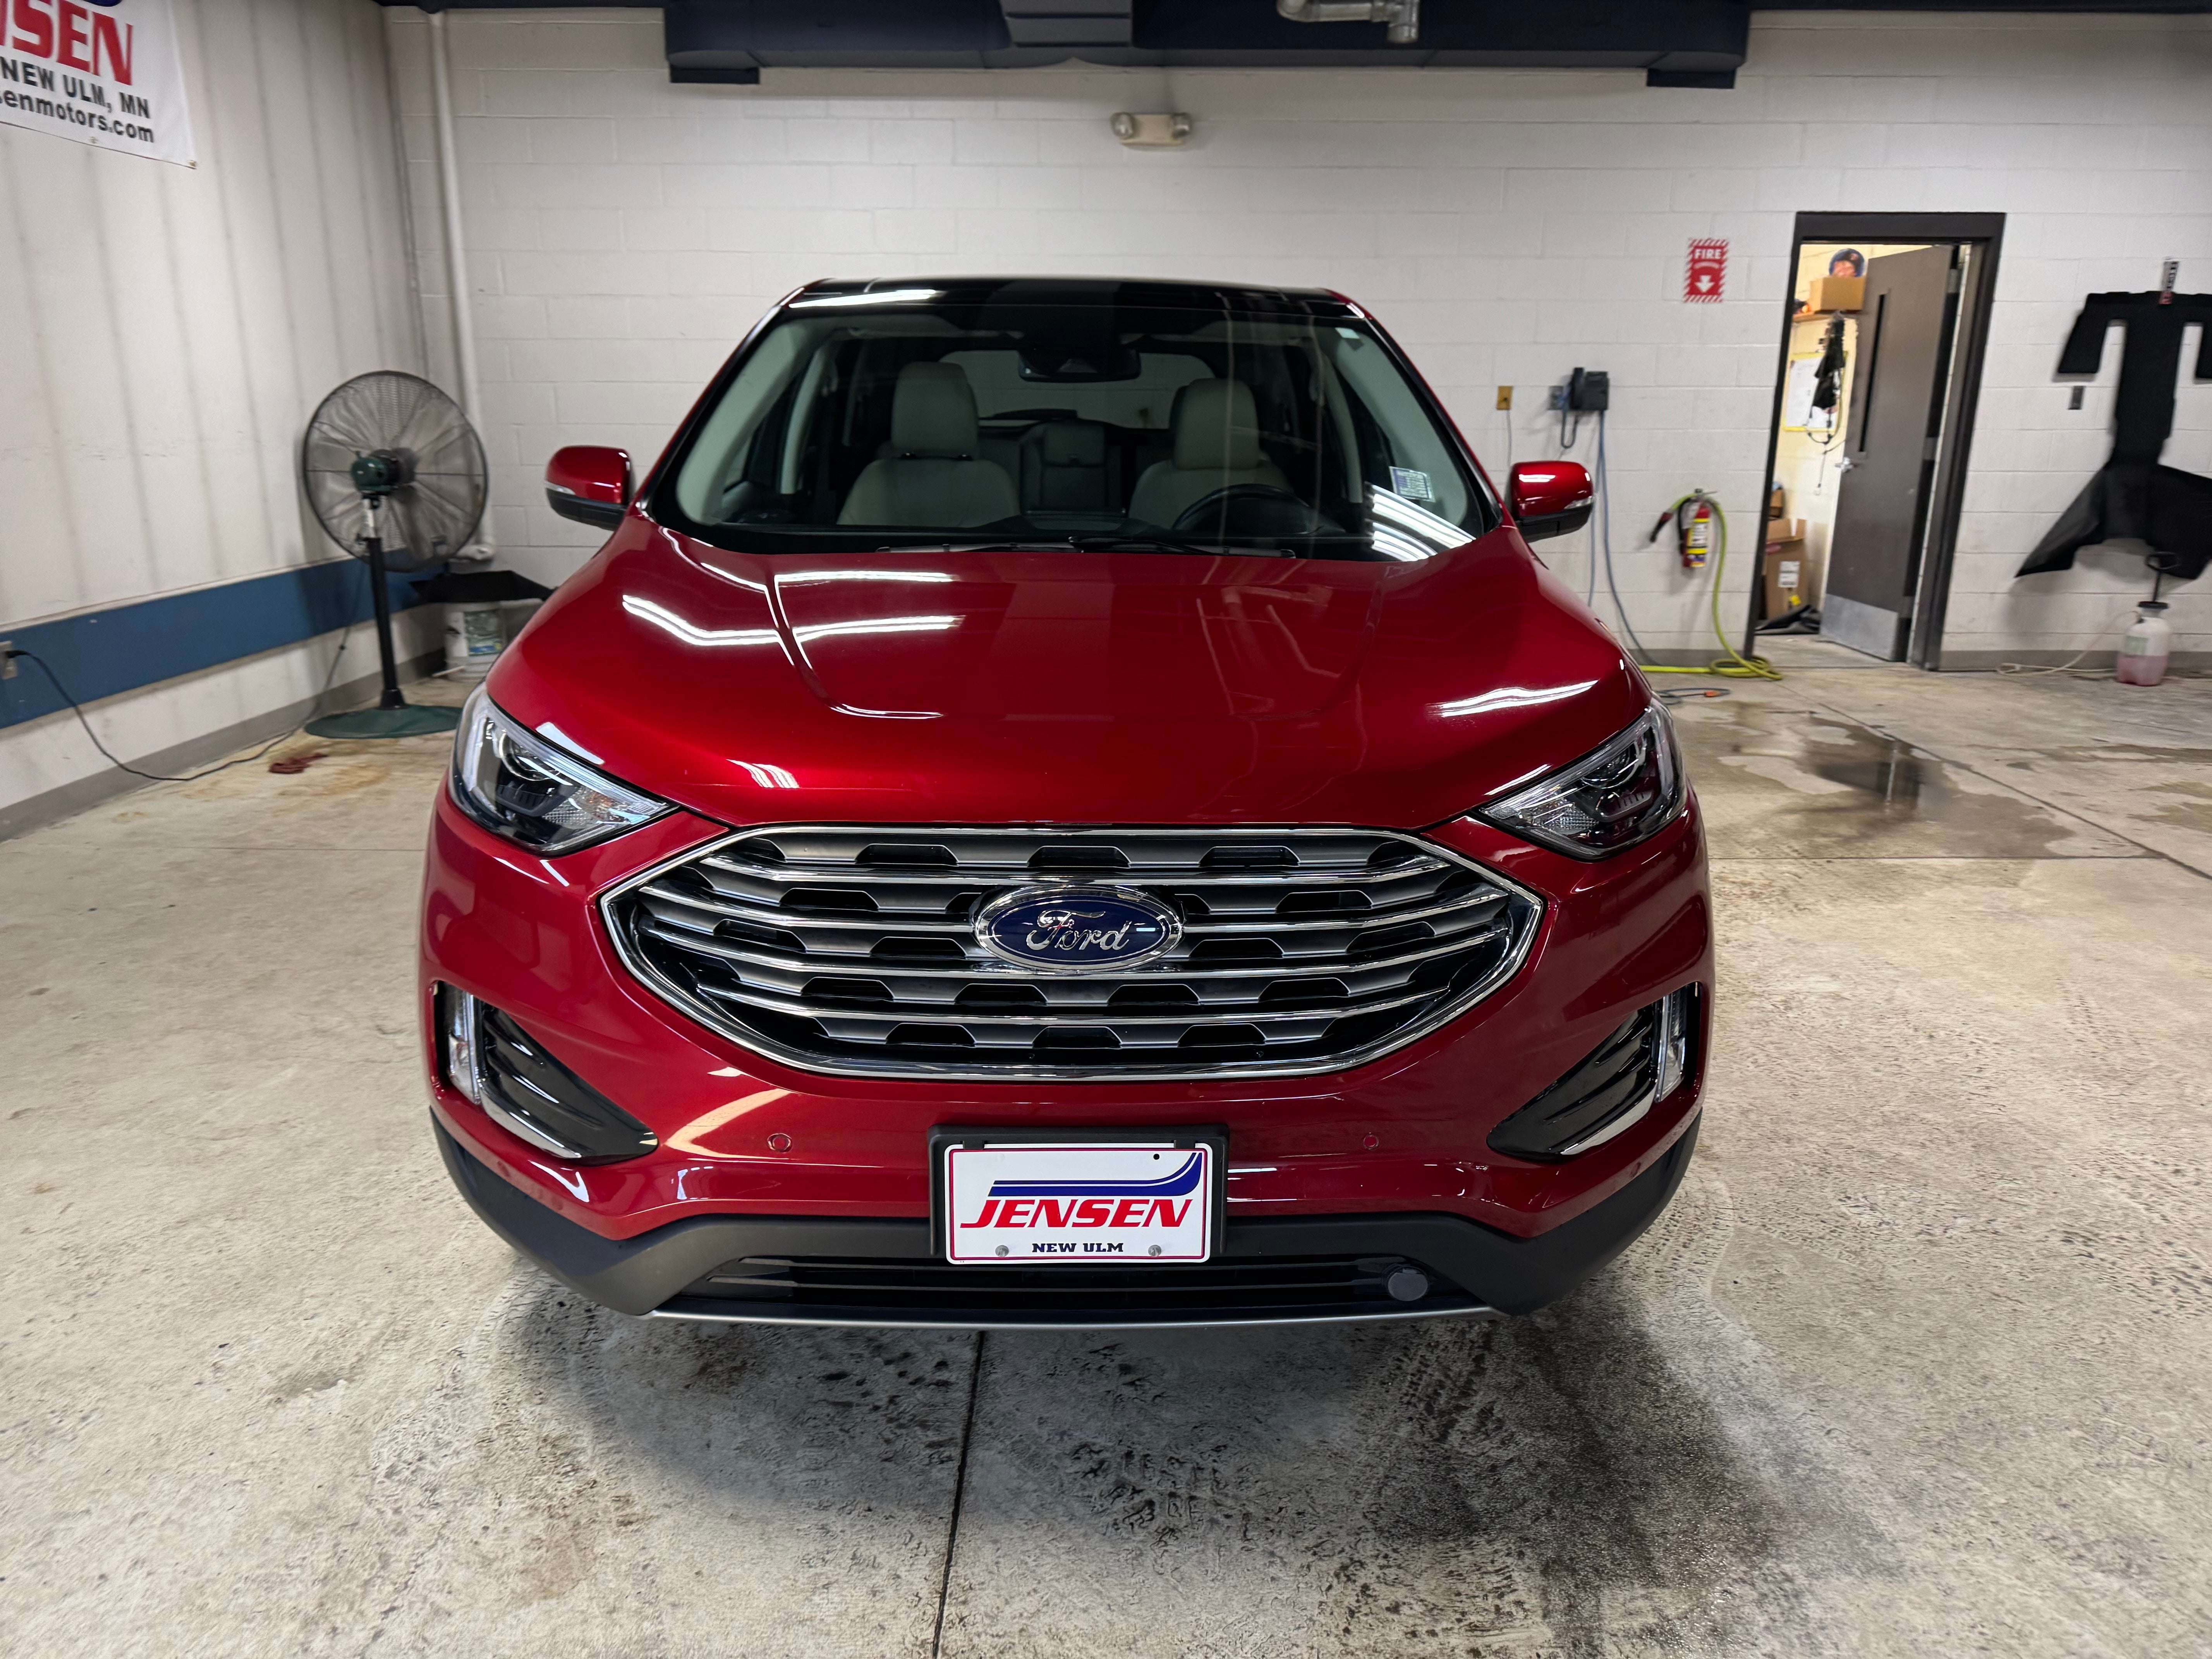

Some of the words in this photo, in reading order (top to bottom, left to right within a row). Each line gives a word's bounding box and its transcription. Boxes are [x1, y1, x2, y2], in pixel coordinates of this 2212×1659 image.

[0, 0, 133, 86] SEN
[0, 56, 54, 91] NEW
[62, 74, 112, 113] ULM,
[119, 91, 151, 118] MN
[0, 90, 154, 143] enmotors.com
[1694, 248, 1722, 259] FIRE
[1026, 909, 1132, 951] Ford
[960, 1199, 1193, 1228] JENSEN
[1032, 1243, 1076, 1253] NEW
[1083, 1242, 1124, 1253] ULM
